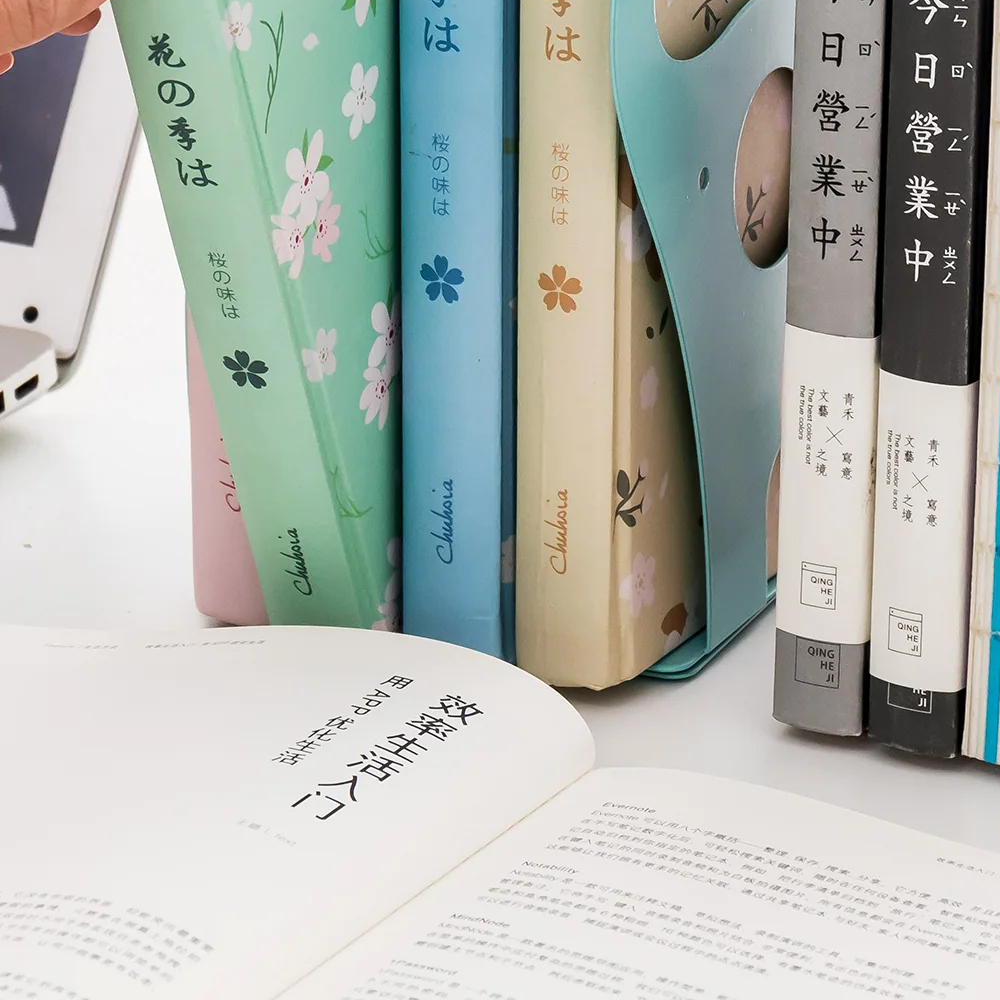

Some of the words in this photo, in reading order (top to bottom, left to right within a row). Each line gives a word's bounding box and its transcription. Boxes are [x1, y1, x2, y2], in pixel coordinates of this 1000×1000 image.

[147, 33, 219, 188] 花の季は
[431, 133, 450, 217] 桜の味は
[550, 142, 570, 226] 桜の味は
[207, 251, 241, 320] 桜の味は
[807, 388, 815, 402] The
[806, 403, 814, 421] best
[805, 422, 813, 442] color
[894, 433, 902, 447] The
[804, 450, 812, 465] not
[893, 449, 901, 467] best
[892, 468, 900, 488] color
[891, 497, 899, 511] not
[810, 576, 833, 587] QING
[821, 587, 833, 597] HE
[825, 597, 833, 606] JI
[897, 622, 919, 633] QING
[906, 634, 919, 643] HE
[807, 645, 835, 660] QING
[911, 644, 919, 653] JI
[820, 660, 834, 671] HE
[380, 673, 415, 691] 用
[826, 672, 834, 683] JI
[351, 689, 392, 717] APP
[917, 697, 927, 708] JI
[271, 715, 356, 768] 优化生活
[290, 693, 485, 820] 效率生活入门
[602, 801, 656, 815] Evernote
[521, 860, 579, 875] Notability
[449, 912, 511, 929] MindNode
